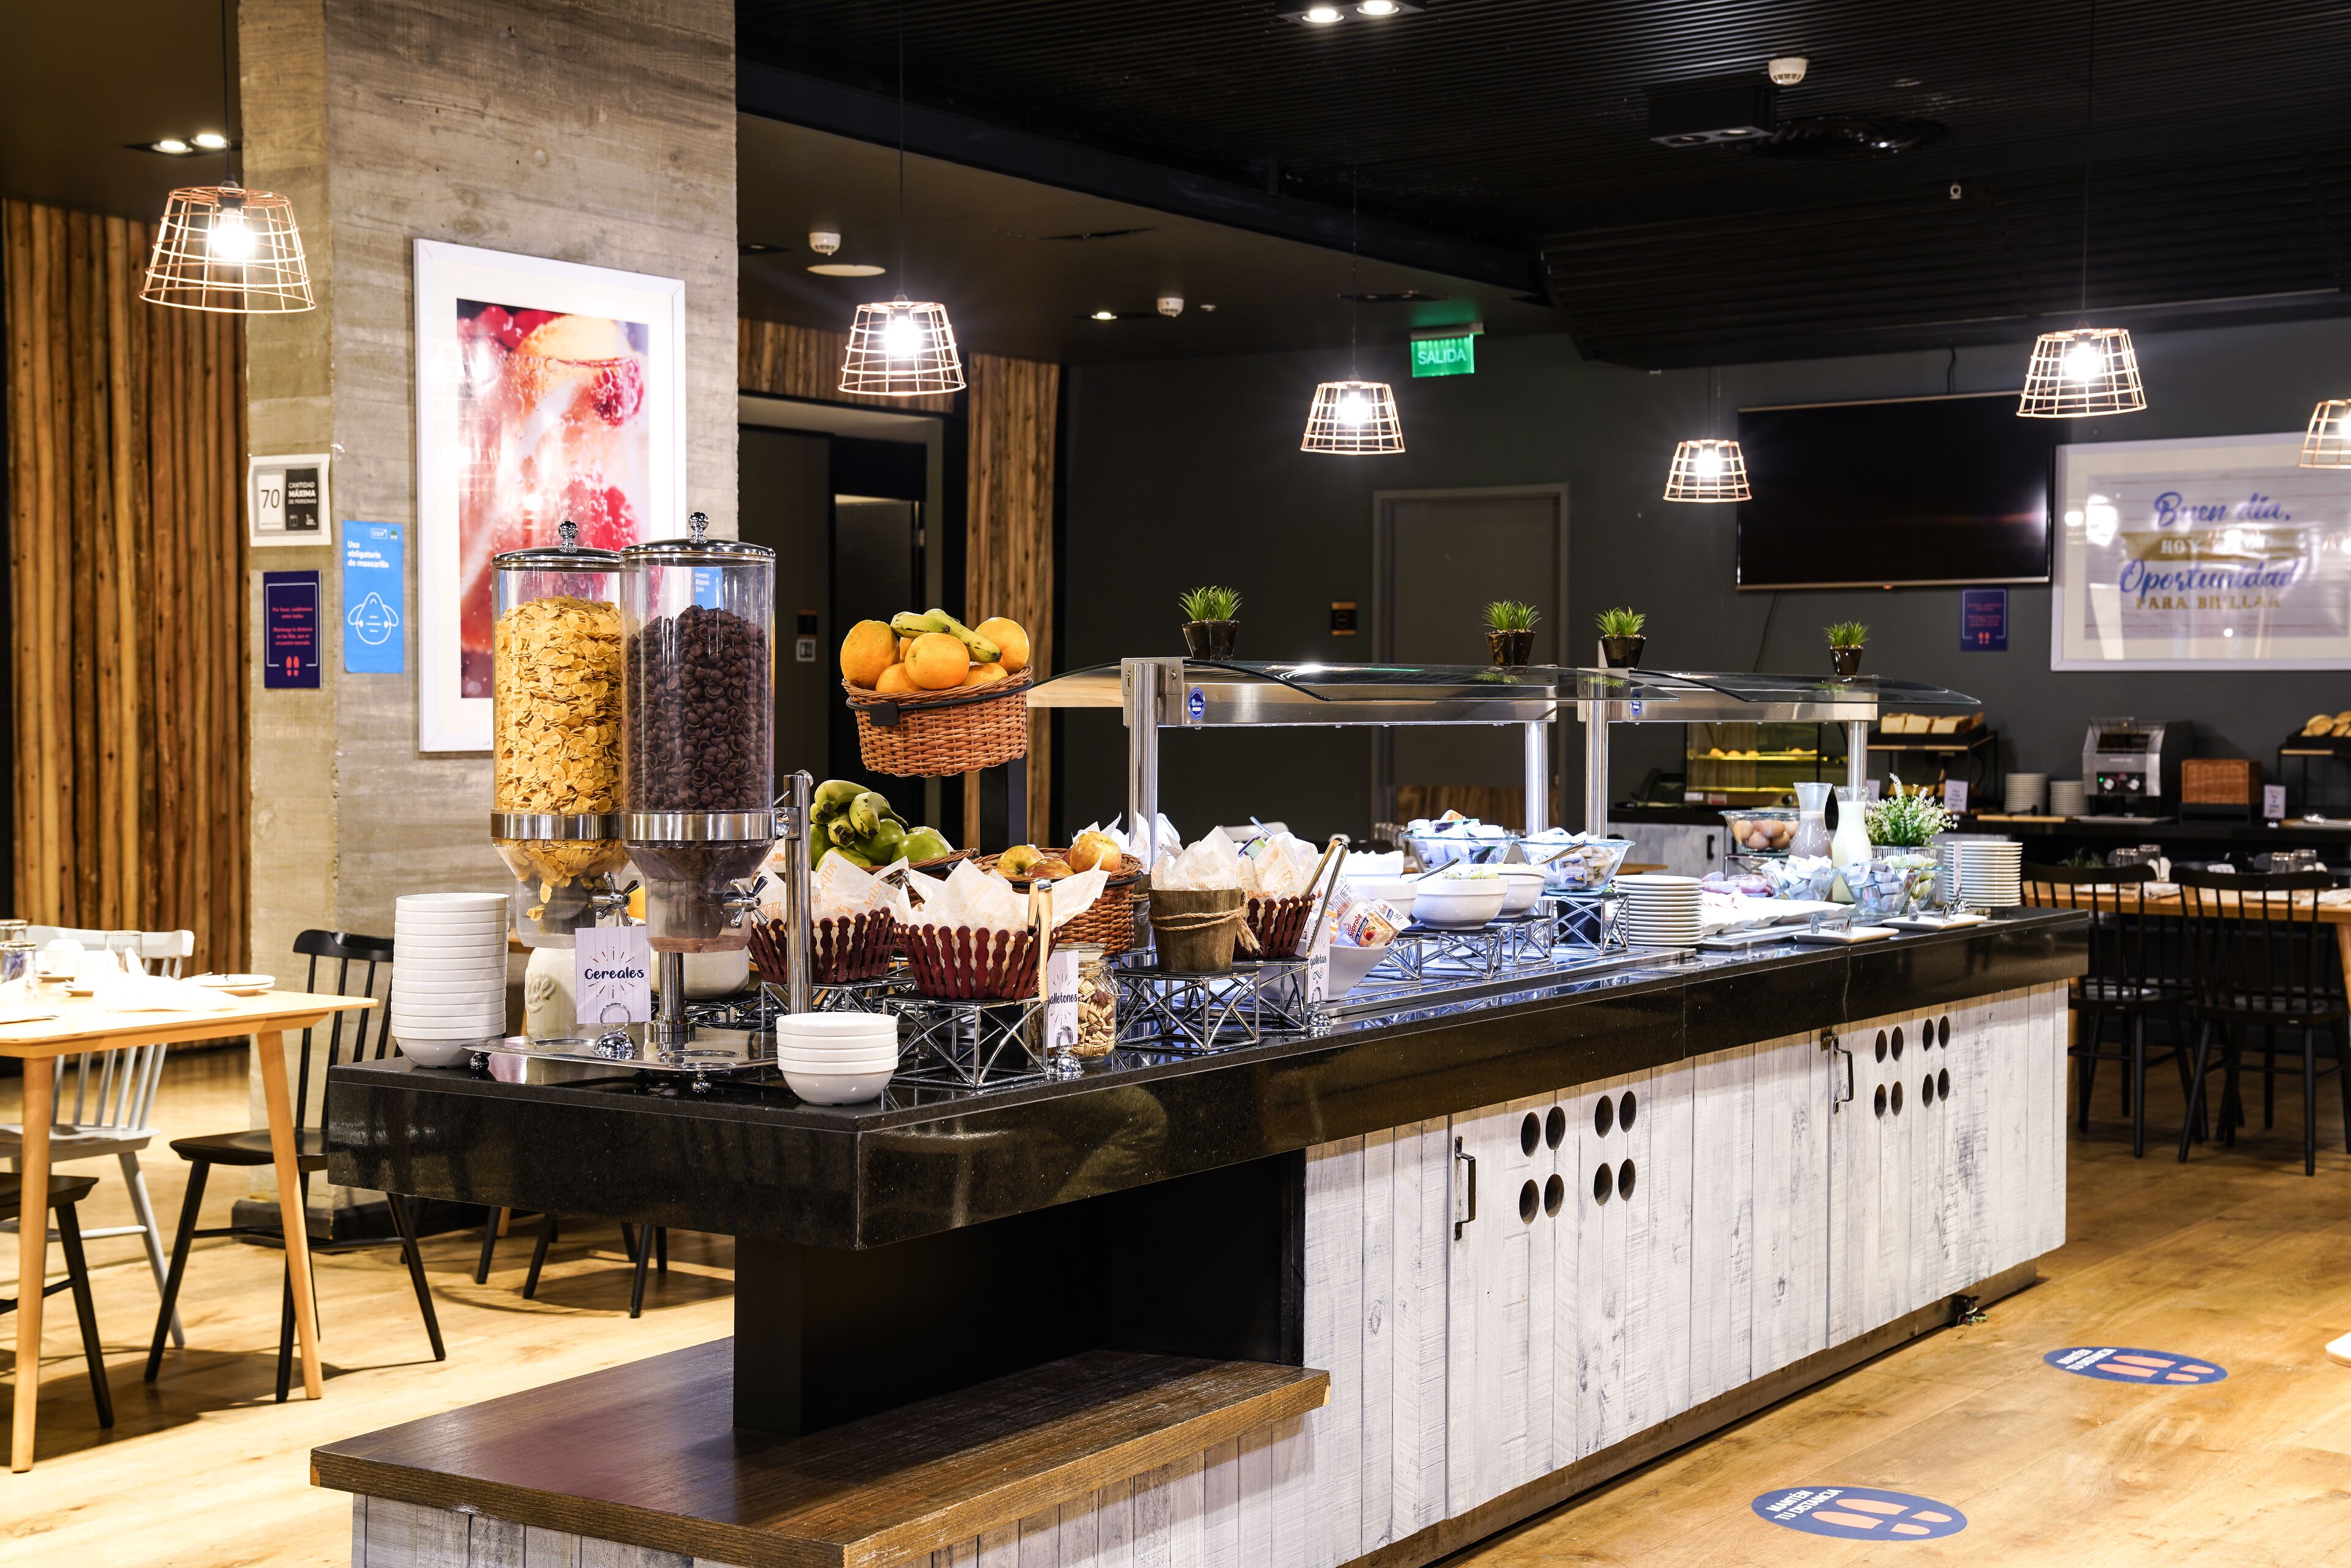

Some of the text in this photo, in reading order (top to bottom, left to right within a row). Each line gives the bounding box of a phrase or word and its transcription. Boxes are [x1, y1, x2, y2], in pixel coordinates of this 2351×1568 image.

[1418, 348, 1467, 365] SALIDA
[260, 489, 280, 509] 70
[2154, 491, 2228, 527] Buen
[2161, 538, 2202, 554] HOY
[2120, 558, 2301, 599] Oportunidad
[2135, 596, 2188, 610] PARA
[1348, 913, 1362, 939] Soprole
[1310, 954, 1327, 970] galletas
[585, 966, 645, 980] Cereales
[1765, 1490, 1815, 1512] MANTÉN
[1774, 1489, 1844, 1520] TU DISTANCIA
